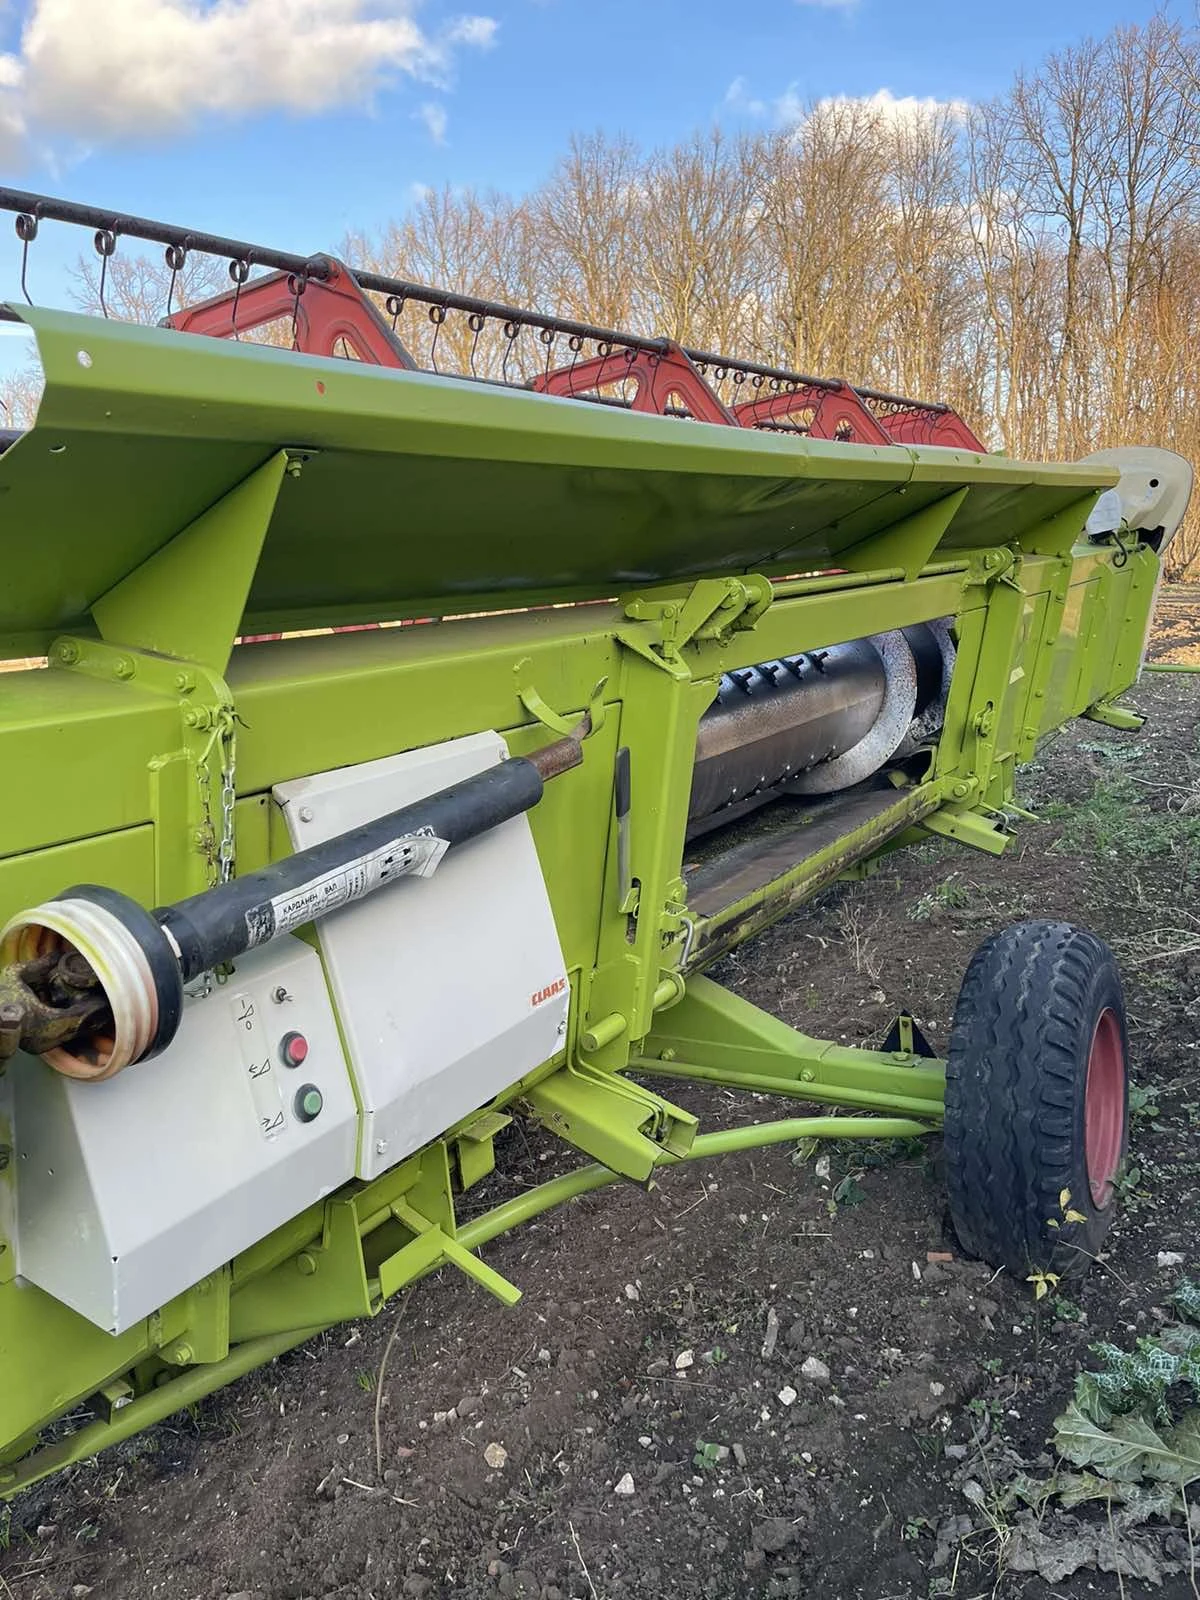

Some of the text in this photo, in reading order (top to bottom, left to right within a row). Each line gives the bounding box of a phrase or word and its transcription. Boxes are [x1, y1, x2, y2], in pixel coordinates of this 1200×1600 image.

[283, 893, 318, 914] КАРДАНЕН
[324, 883, 338, 895] ВАЛ
[532, 978, 566, 1006] CLAAS
